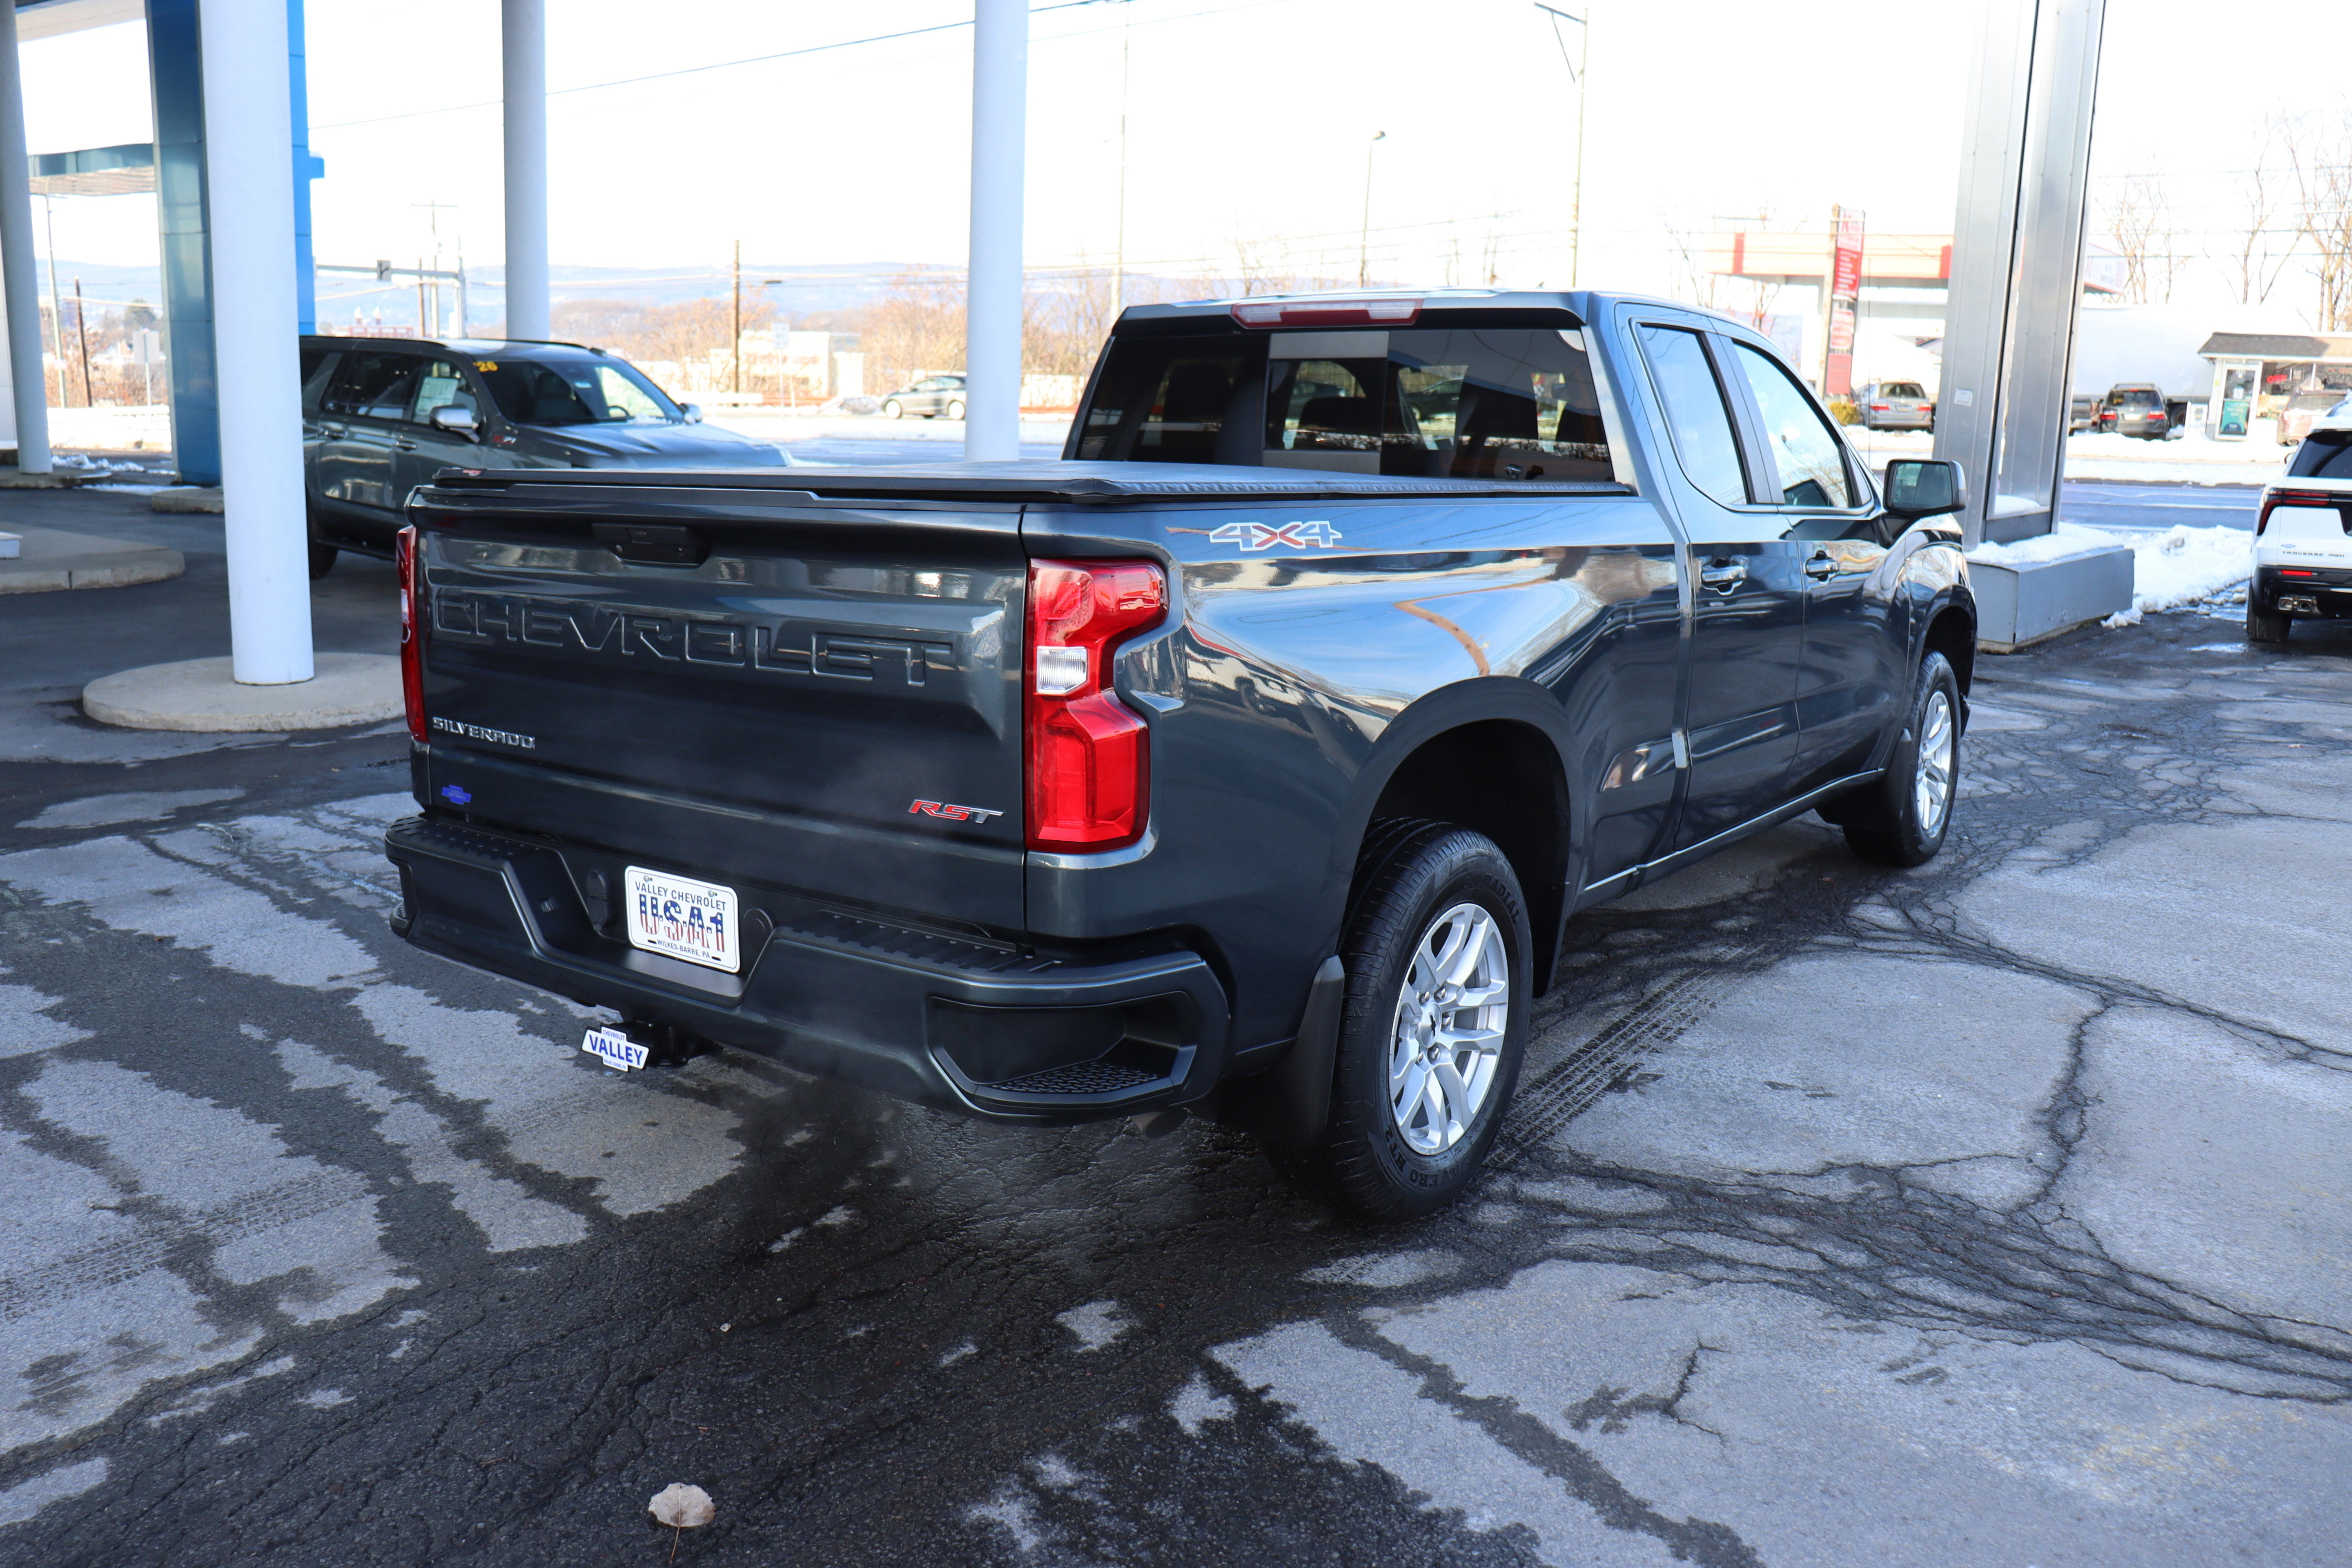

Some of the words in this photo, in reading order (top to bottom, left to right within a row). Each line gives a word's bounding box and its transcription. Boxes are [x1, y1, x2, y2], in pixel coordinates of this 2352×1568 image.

[435, 594, 956, 686] CHEVROLET
[432, 717, 535, 749] SILVERADO
[908, 799, 1006, 824] RST
[635, 881, 668, 897] VALLEY
[671, 890, 726, 911] CHEVROLET
[657, 939, 701, 957] WILKES-BARRE,
[589, 1034, 643, 1065] VALLEY
[603, 1029, 625, 1041] CHEVROLET
